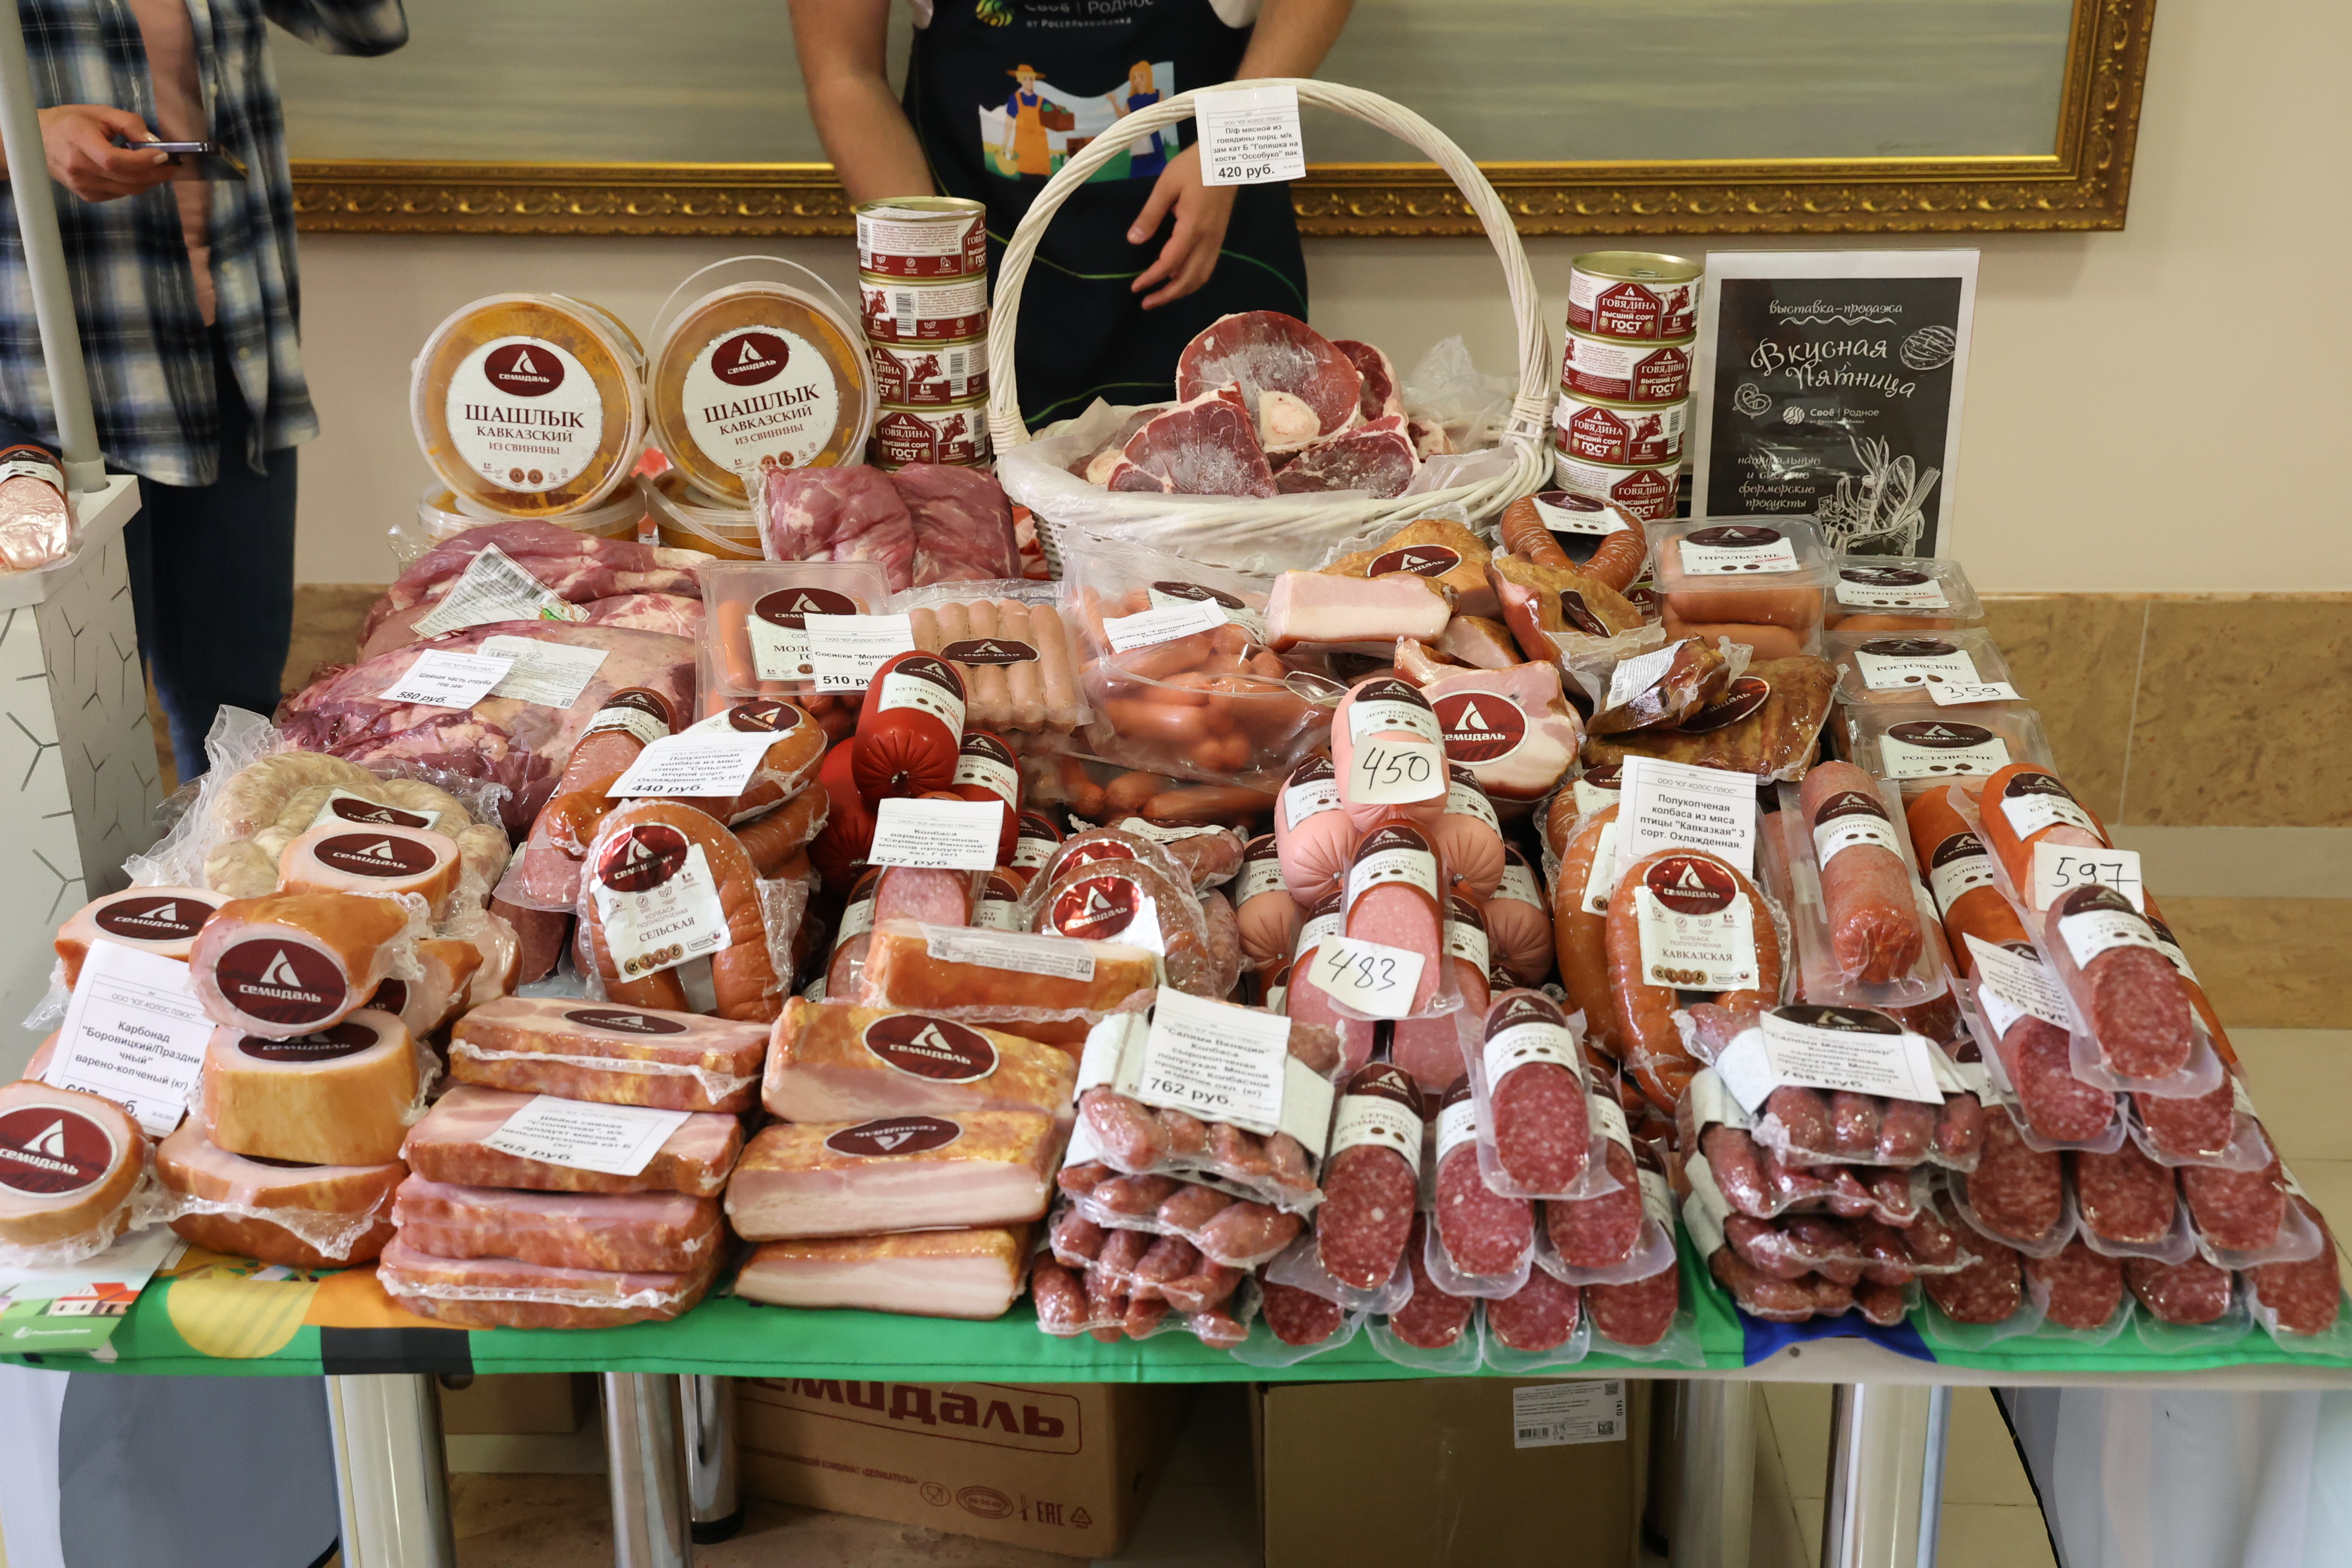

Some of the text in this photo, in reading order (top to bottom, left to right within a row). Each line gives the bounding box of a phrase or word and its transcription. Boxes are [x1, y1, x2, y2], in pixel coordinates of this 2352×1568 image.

[1238, 152, 1282, 161] "Оссобуко"
[1219, 164, 1275, 178] 420 руб.
[1602, 298, 1656, 310] ГОВЯДИНА
[1602, 311, 1634, 319] ВЫСШИЙ
[1612, 320, 1642, 330] ГОСТ
[1751, 338, 1887, 377] Вкусная
[727, 357, 776, 375] семидаль
[1641, 363, 1685, 373] ГОВЯДИНА
[498, 373, 550, 384] семидаль
[1785, 361, 1916, 398] Пятница
[1651, 384, 1675, 393] ГОСТ
[702, 384, 820, 424] ШАШЛЫК
[465, 404, 584, 429] ШАШЛЫК
[720, 404, 813, 435] КАВКАЗСКИЙ
[1810, 408, 1879, 417] Своё Родное
[476, 425, 573, 444] КАВКАЗСКИЙ
[734, 424, 805, 446] ИЗ СВИНИНЫ
[881, 427, 930, 438] ГОВЯДИНА
[1574, 420, 1623, 436] ГОВЯДИНА
[1574, 432, 1602, 444] ВЫСШИЙ
[489, 442, 560, 455] ИЗ СВИНИНЫ
[891, 449, 918, 458] ГОСТ
[1582, 442, 1609, 454] ГОСТ
[1618, 485, 1665, 495] ГОВЯДИНА
[1739, 482, 1815, 497] фермерские
[1746, 498, 1806, 511] продукты
[1111, 632, 1146, 642] Сосиски
[419, 695, 447, 703] руб.
[1944, 686, 2002, 698] 359
[896, 687, 959, 720] БУТЕРБРОДНАЯ
[1366, 710, 1431, 727] ДОКТОРСКАЯ
[1442, 730, 1506, 742] емидаль
[1362, 747, 1430, 790] 450
[667, 784, 704, 794] руб.
[1675, 780, 1712, 791] "ЮГ-КОЛОС
[1658, 794, 1730, 812] Полукопченая
[1640, 817, 1672, 827] птицы
[1652, 807, 1692, 819] колбаса
[1710, 816, 1734, 825] мяса
[879, 837, 935, 847] "Сервелат
[890, 833, 979, 843] варено-копченая
[1641, 828, 1667, 839] сорт.
[1671, 832, 1742, 849] Охлажденная.
[333, 850, 407, 869] семидаль
[2052, 857, 2139, 893] 597
[1663, 888, 1720, 898] семидаль
[637, 908, 689, 930] ПОЛУКОПЧЕНАЯ
[645, 906, 676, 919] КОЛБАСА
[113, 915, 190, 931] семидаль
[639, 917, 696, 942] СЕЛЬСКАЯ
[1663, 948, 1733, 961] КАВКАЗСКАЯ
[1328, 949, 1396, 991] 483
[239, 984, 322, 1003] семидаль
[112, 993, 196, 1019] ООО "ЮГ-КОЛОС ПЛЮС"
[118, 1021, 171, 1043] Карбонад
[83, 1025, 201, 1064] "Боровицкий/Праздни
[1191, 1043, 1239, 1057] Колбаса
[119, 1052, 153, 1064] чный"
[889, 1044, 972, 1065] семидаль
[75, 1054, 188, 1092] варено-копченый (кг)
[1224, 1066, 1269, 1079] Мясной
[1150, 1077, 1235, 1107] 762 руб.
[531, 1150, 574, 1162] руб.
